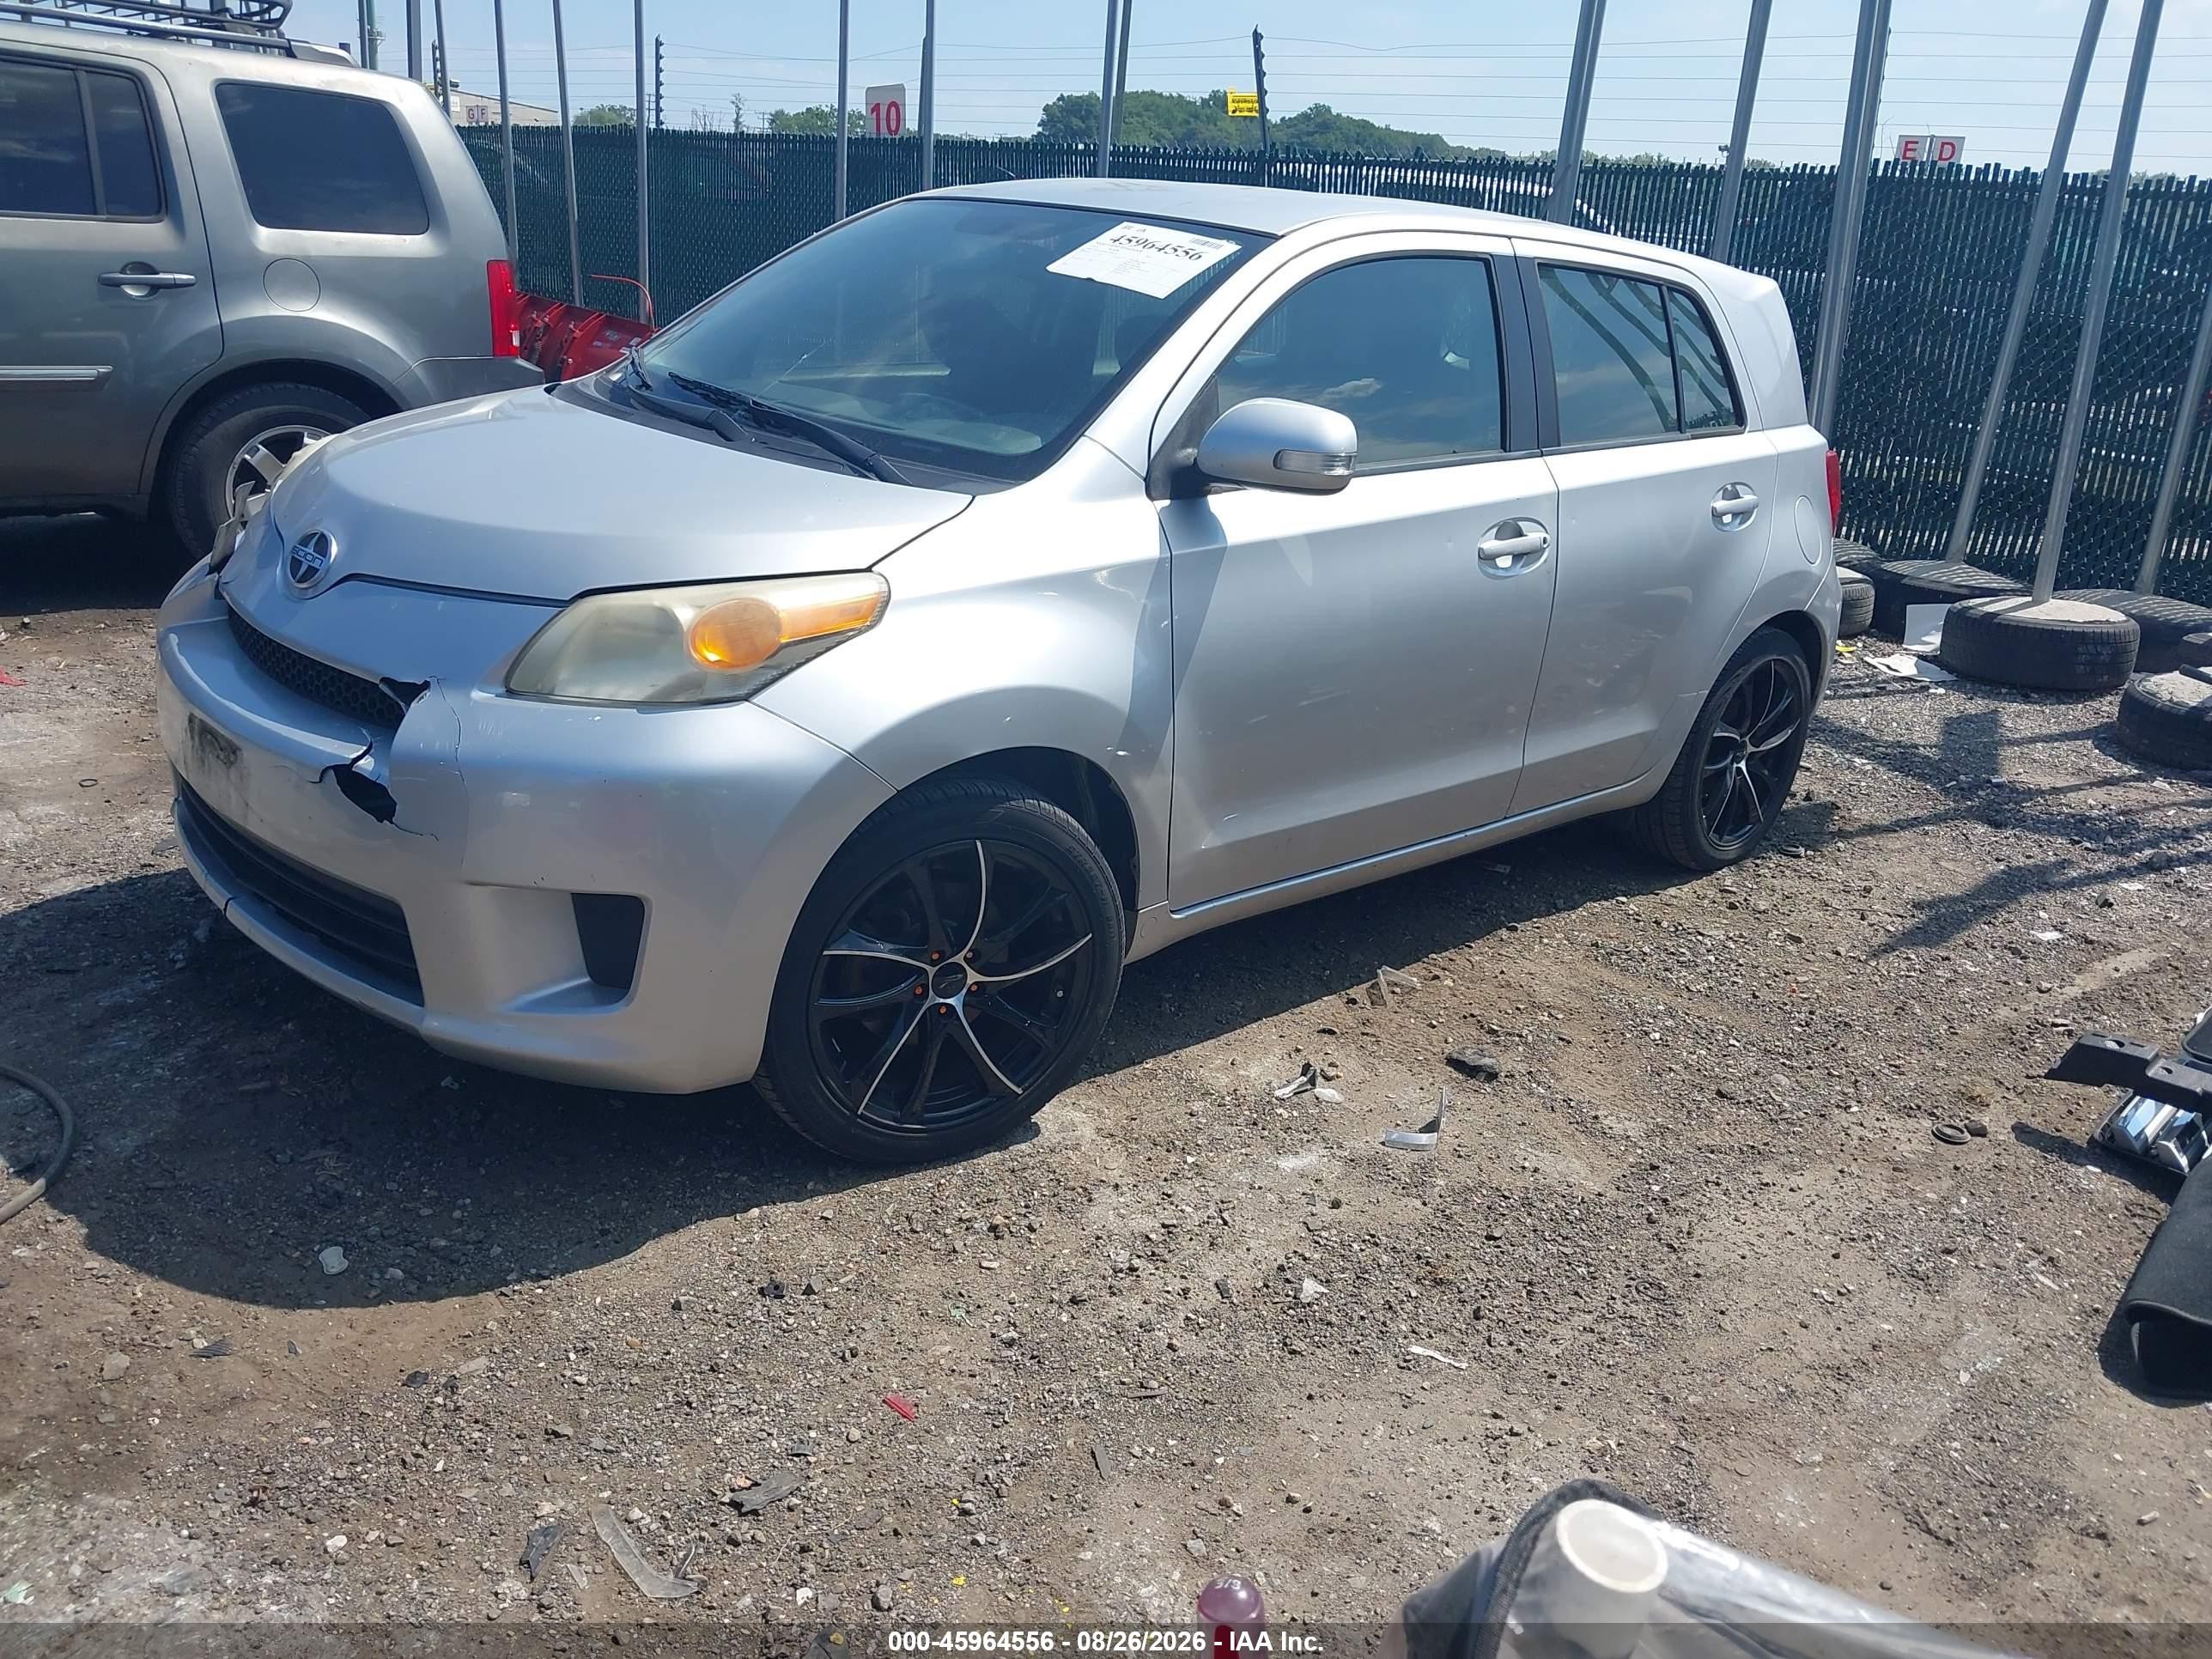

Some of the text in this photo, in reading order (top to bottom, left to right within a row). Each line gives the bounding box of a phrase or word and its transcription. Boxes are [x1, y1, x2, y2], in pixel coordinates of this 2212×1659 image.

[468, 108, 475, 119] G
[481, 108, 486, 118] F
[871, 100, 901, 137] 10
[1901, 140, 1919, 161] E
[1938, 141, 1956, 161] D
[1109, 234, 1208, 262] 45964556
[292, 544, 324, 568] SCION
